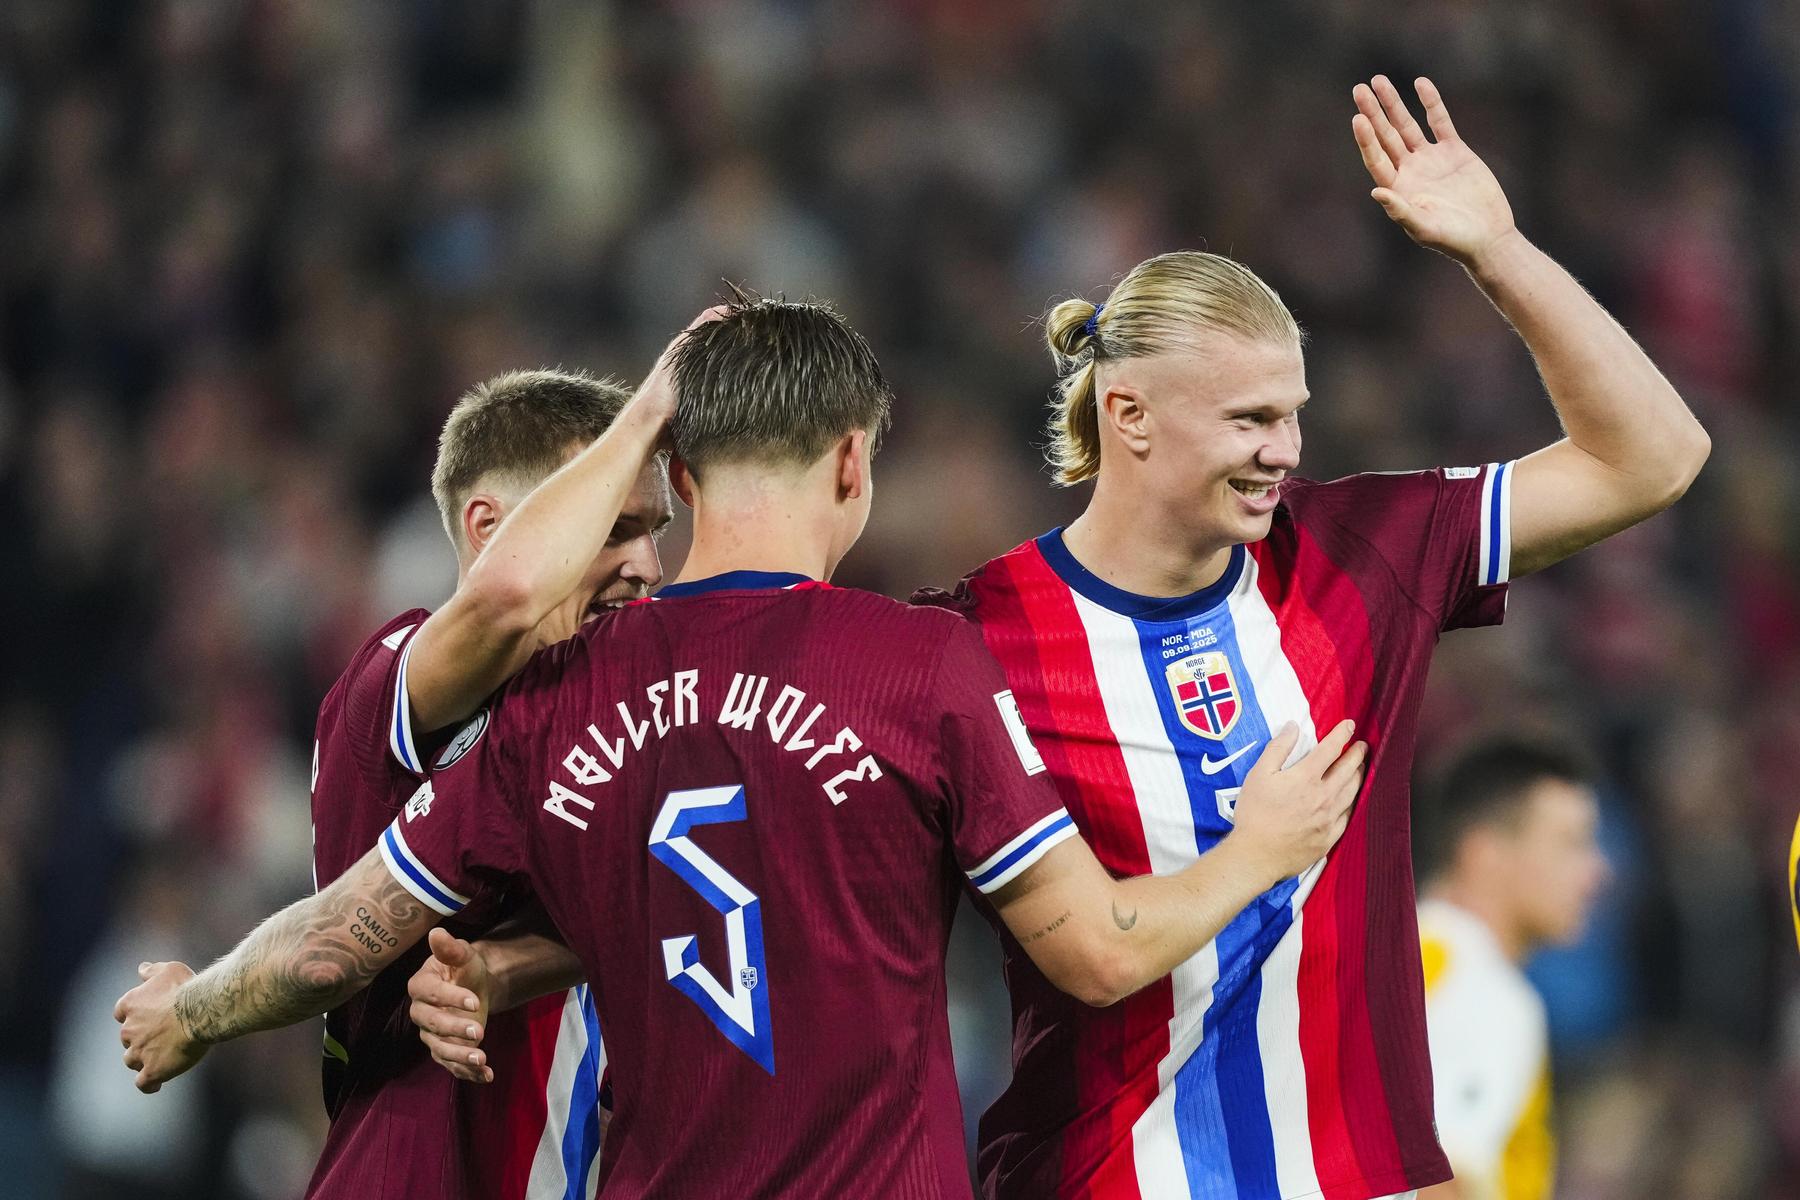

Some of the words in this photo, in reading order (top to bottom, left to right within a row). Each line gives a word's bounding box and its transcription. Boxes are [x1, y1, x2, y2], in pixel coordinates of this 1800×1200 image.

[1161, 634, 1183, 646] NOR
[1190, 628, 1213, 640] MDA
[1162, 635, 1217, 658] 09.09.2025
[1185, 657, 1206, 668] NORGE
[543, 669, 699, 831] MØLLER
[717, 672, 884, 806] WOLFE
[350, 923, 383, 954] CANO
[356, 906, 398, 948] CAMILO
[648, 783, 776, 1077] 5
